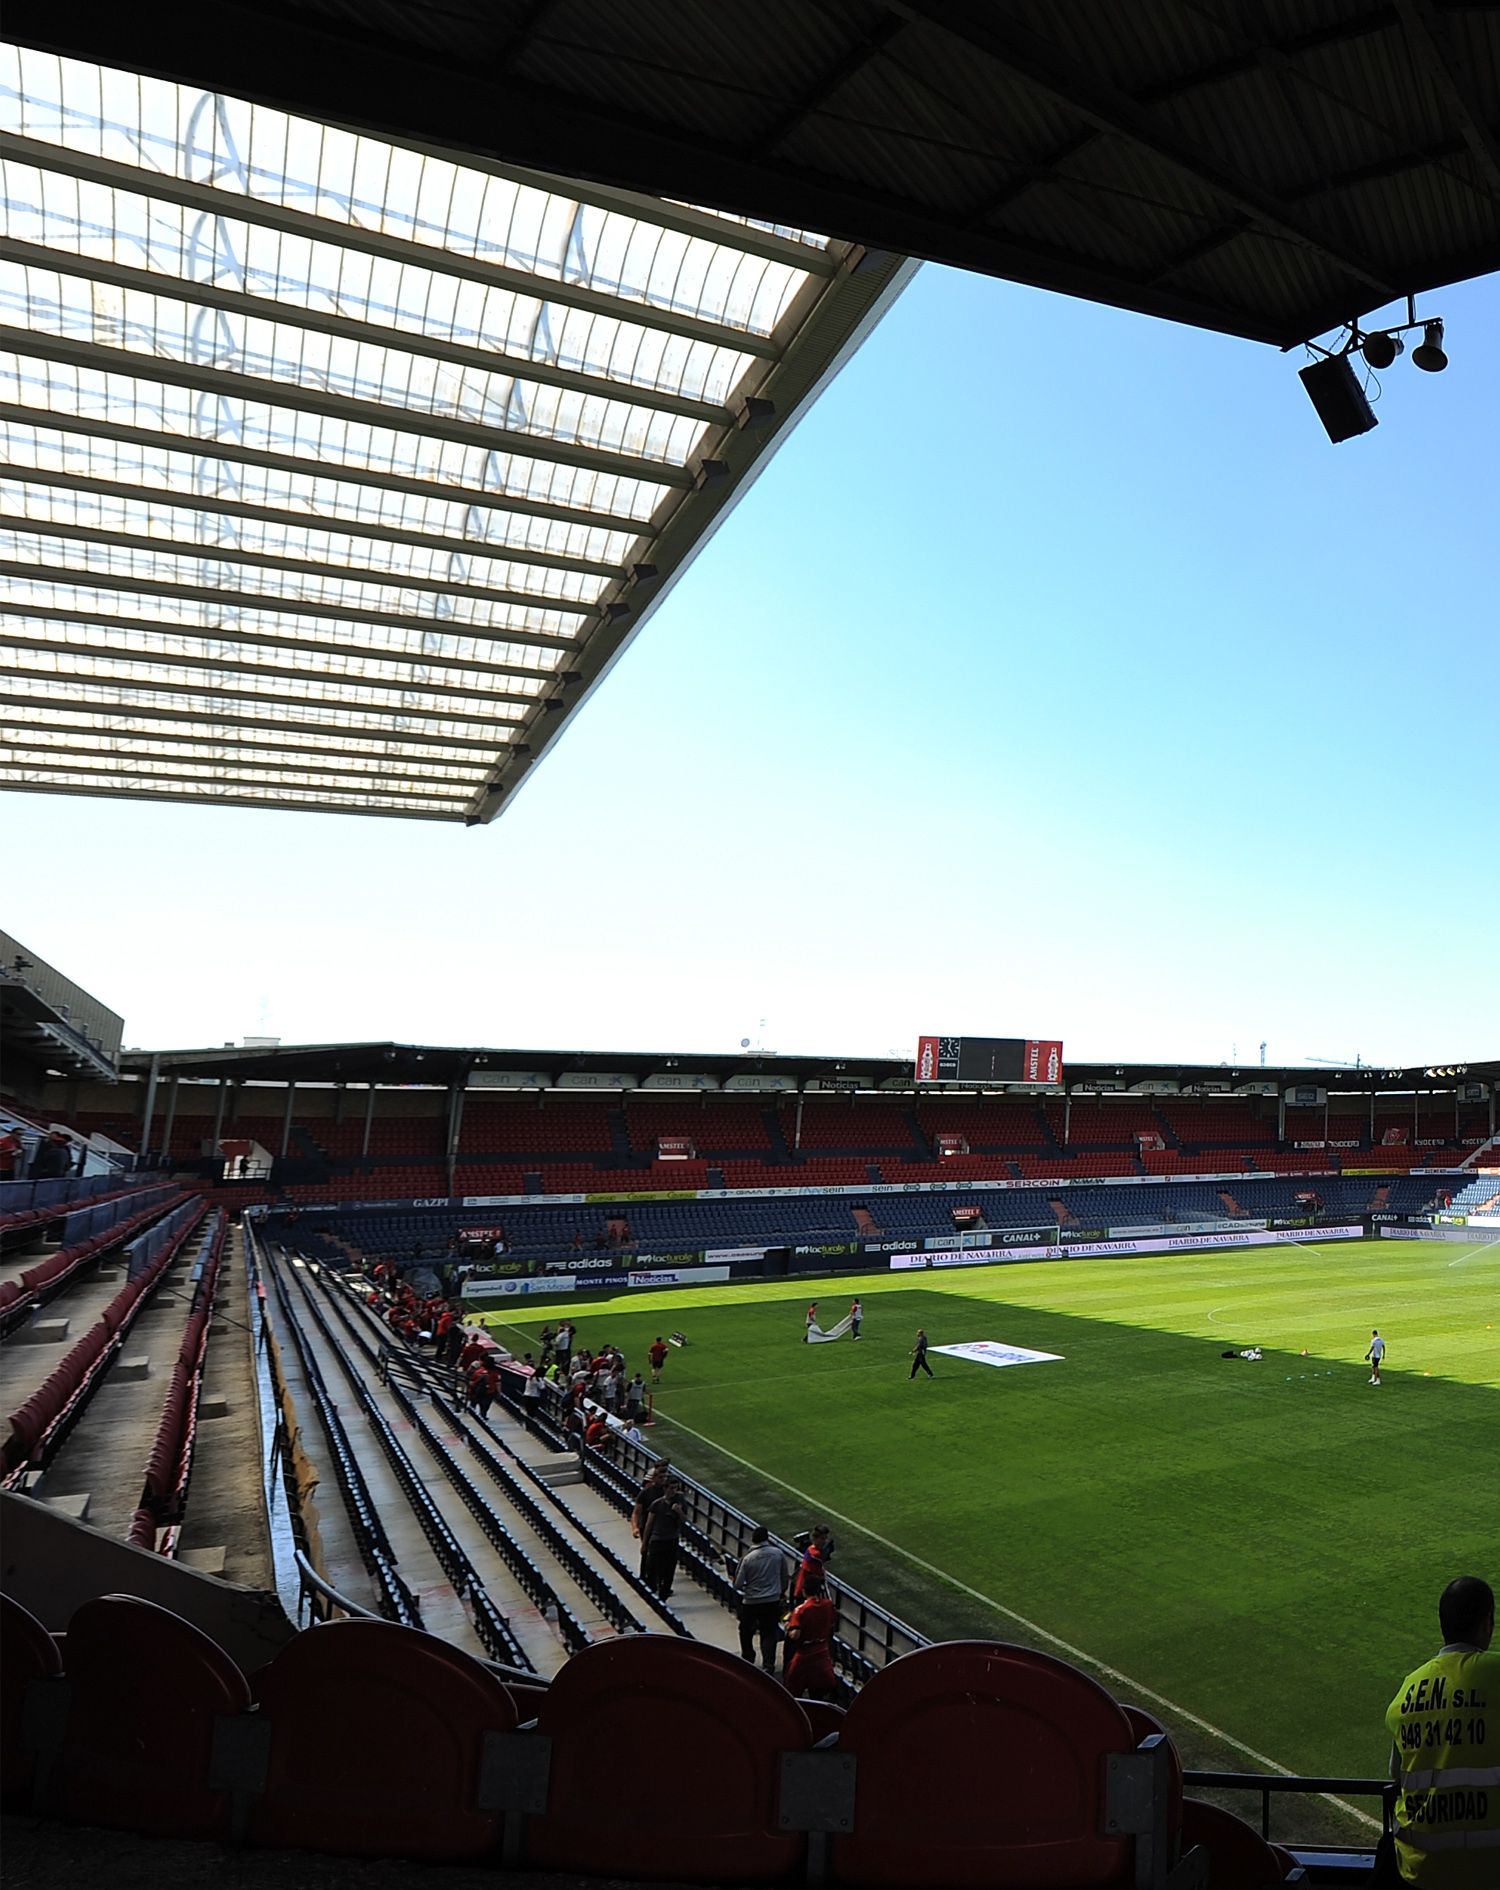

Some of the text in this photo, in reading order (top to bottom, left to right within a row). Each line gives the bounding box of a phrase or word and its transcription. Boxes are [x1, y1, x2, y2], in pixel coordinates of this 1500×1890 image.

[1030, 1048, 1039, 1080] AMSTEL
[571, 1075, 597, 1085] can
[657, 1076, 681, 1086] can
[737, 1077, 760, 1087] can
[892, 1079, 911, 1087] can
[822, 1081, 859, 1090] Noticias
[1084, 1083, 1114, 1091] Noticias
[1193, 1085, 1221, 1093] Noticias
[1006, 1180, 1060, 1188] SERCOIN
[413, 1199, 449, 1207] GAZPI
[1372, 1214, 1398, 1222] CANAL+
[1003, 1233, 1041, 1243] CANAL+
[1277, 1230, 1303, 1238] DIARIO
[1316, 1228, 1350, 1236] NAVARRA
[937, 1238, 955, 1247] can
[1169, 1234, 1249, 1246] DIARIO DE NAVARRA
[809, 1244, 846, 1255] lacturale
[882, 1241, 917, 1251] adidas
[1047, 1241, 1137, 1254] DIARIO DE NAVARRA
[653, 1253, 693, 1264] lacturale
[910, 1249, 1013, 1263] DIARIO DE NAVARRA
[568, 1258, 613, 1269] adidas
[475, 1263, 522, 1275] lacturale
[576, 1276, 628, 1285] MONTE PINOS
[635, 1273, 673, 1284] Noticias
[1401, 1677, 1447, 1714] S.E.N.
[1401, 1718, 1485, 1750] 948 31 42 10
